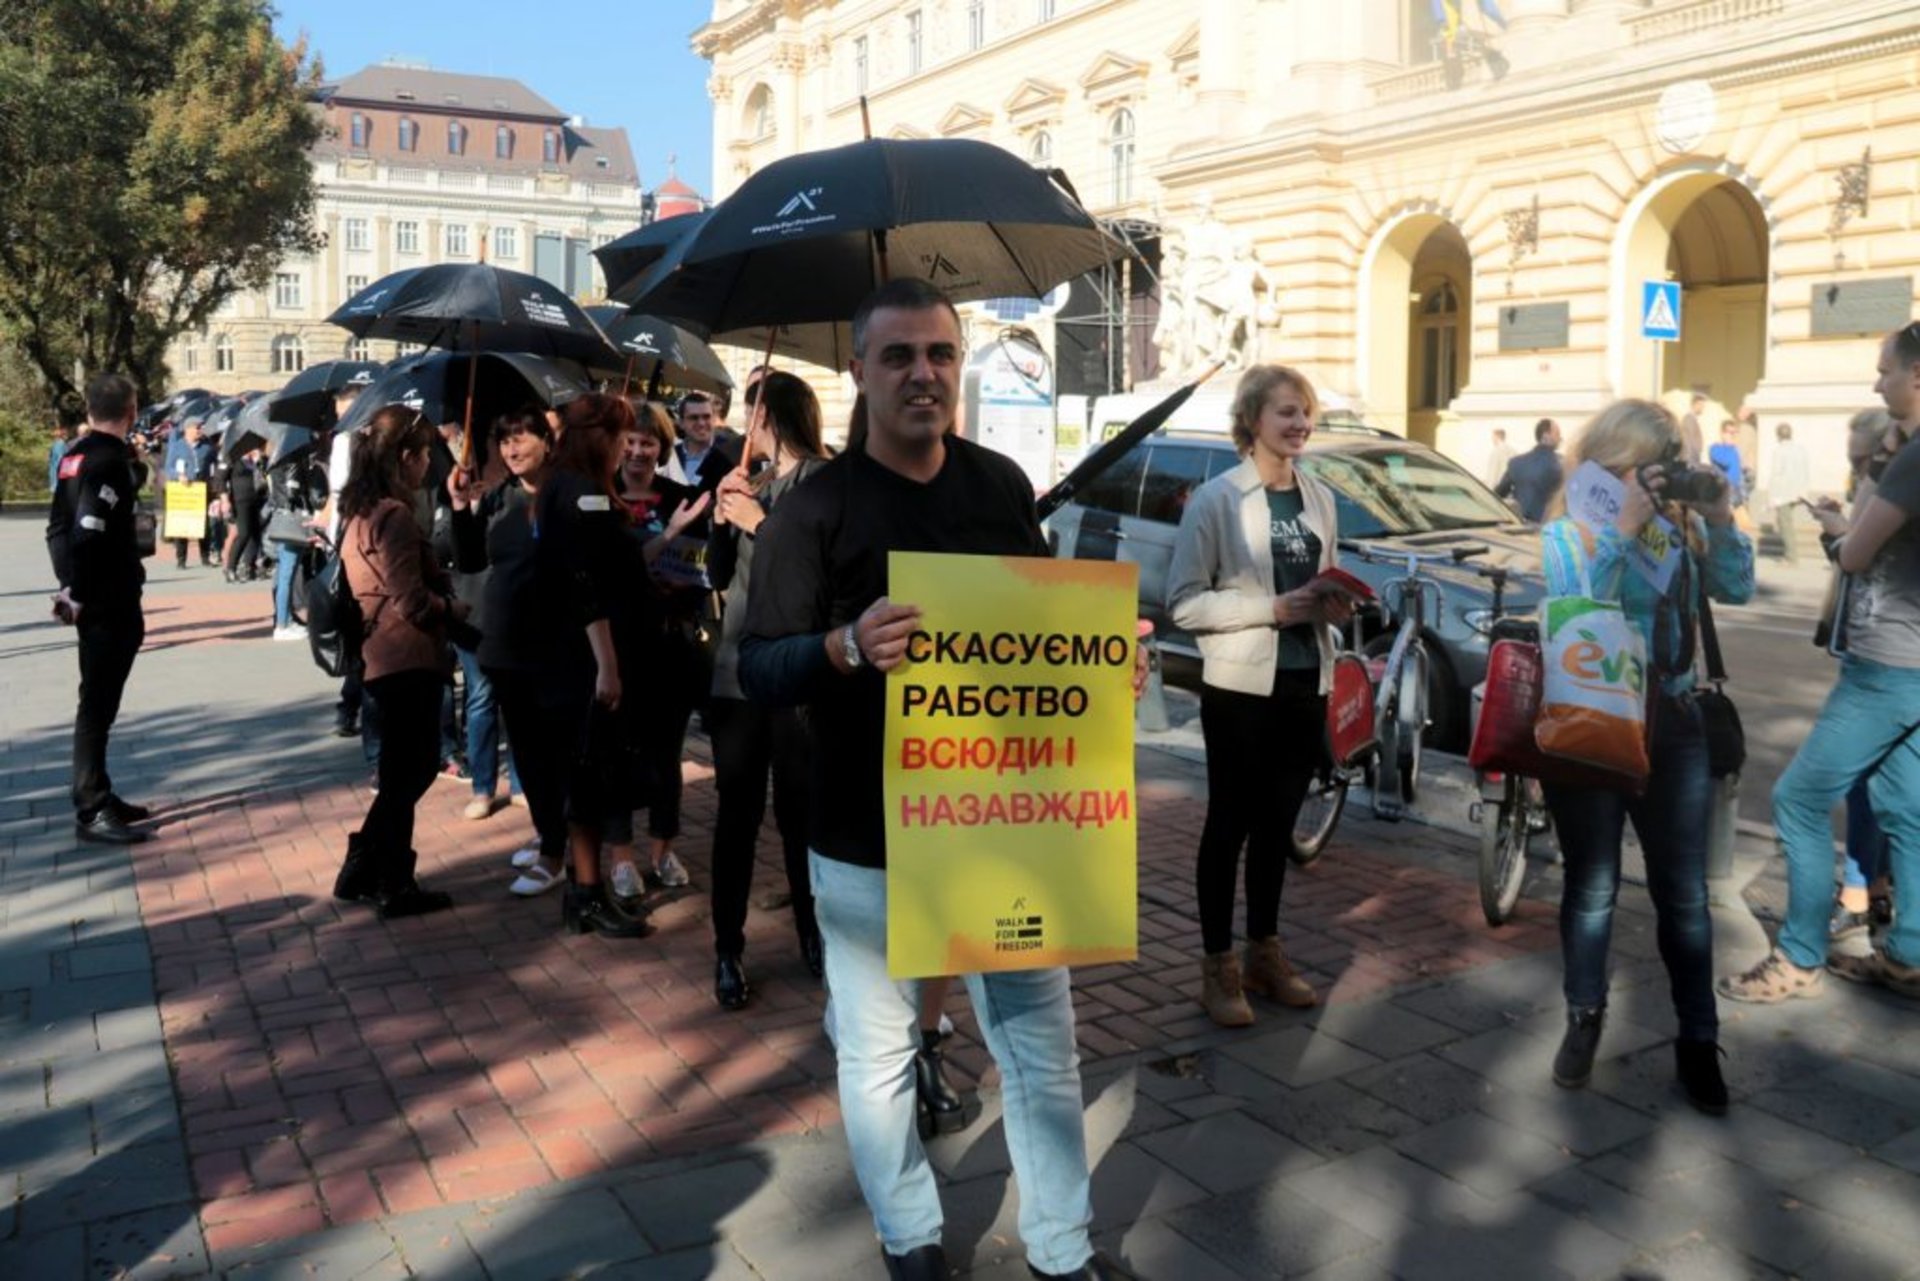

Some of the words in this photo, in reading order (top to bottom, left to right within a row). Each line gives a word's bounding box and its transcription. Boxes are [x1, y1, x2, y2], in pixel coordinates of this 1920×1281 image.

[905, 630, 1129, 667] СКАСУЄМО
[902, 684, 1089, 718] РАБСТВО
[901, 736, 1054, 776] ВСЮДИ
[901, 790, 1130, 829] НАЗАВЖДИ
[994, 917, 1025, 928] WALK
[994, 929, 1016, 940] FOR
[994, 940, 1043, 952] FREEDOM
